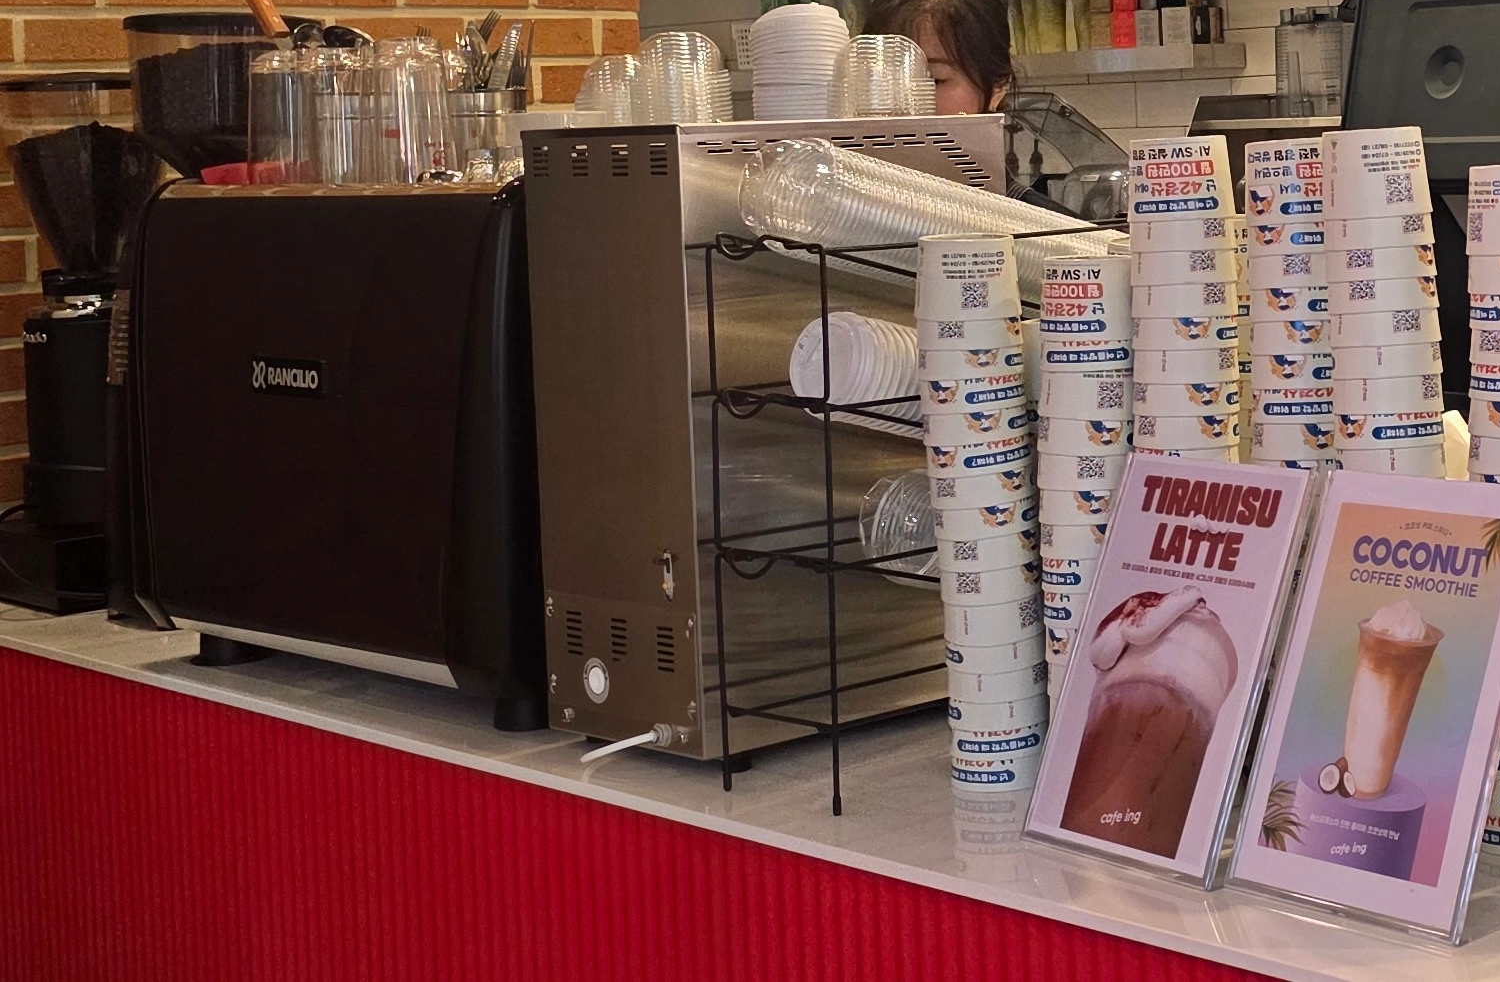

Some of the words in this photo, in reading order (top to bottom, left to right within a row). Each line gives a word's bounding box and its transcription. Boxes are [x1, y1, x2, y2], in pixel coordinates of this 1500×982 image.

[1206, 179, 1216, 192] 난
[1092, 302, 1105, 315] 난
[267, 366, 319, 389] RANCILIO
[1141, 475, 1283, 528] TIRAMISU
[1149, 522, 1244, 571] LATTE
[1353, 535, 1488, 578] COCONUT
[1350, 568, 1402, 587] COFFEE
[1404, 575, 1479, 598] SMOOTHIE
[1101, 809, 1123, 824] cafe
[1125, 809, 1141, 824] ing
[1330, 843, 1350, 855] cafe
[1352, 842, 1367, 855] ing
